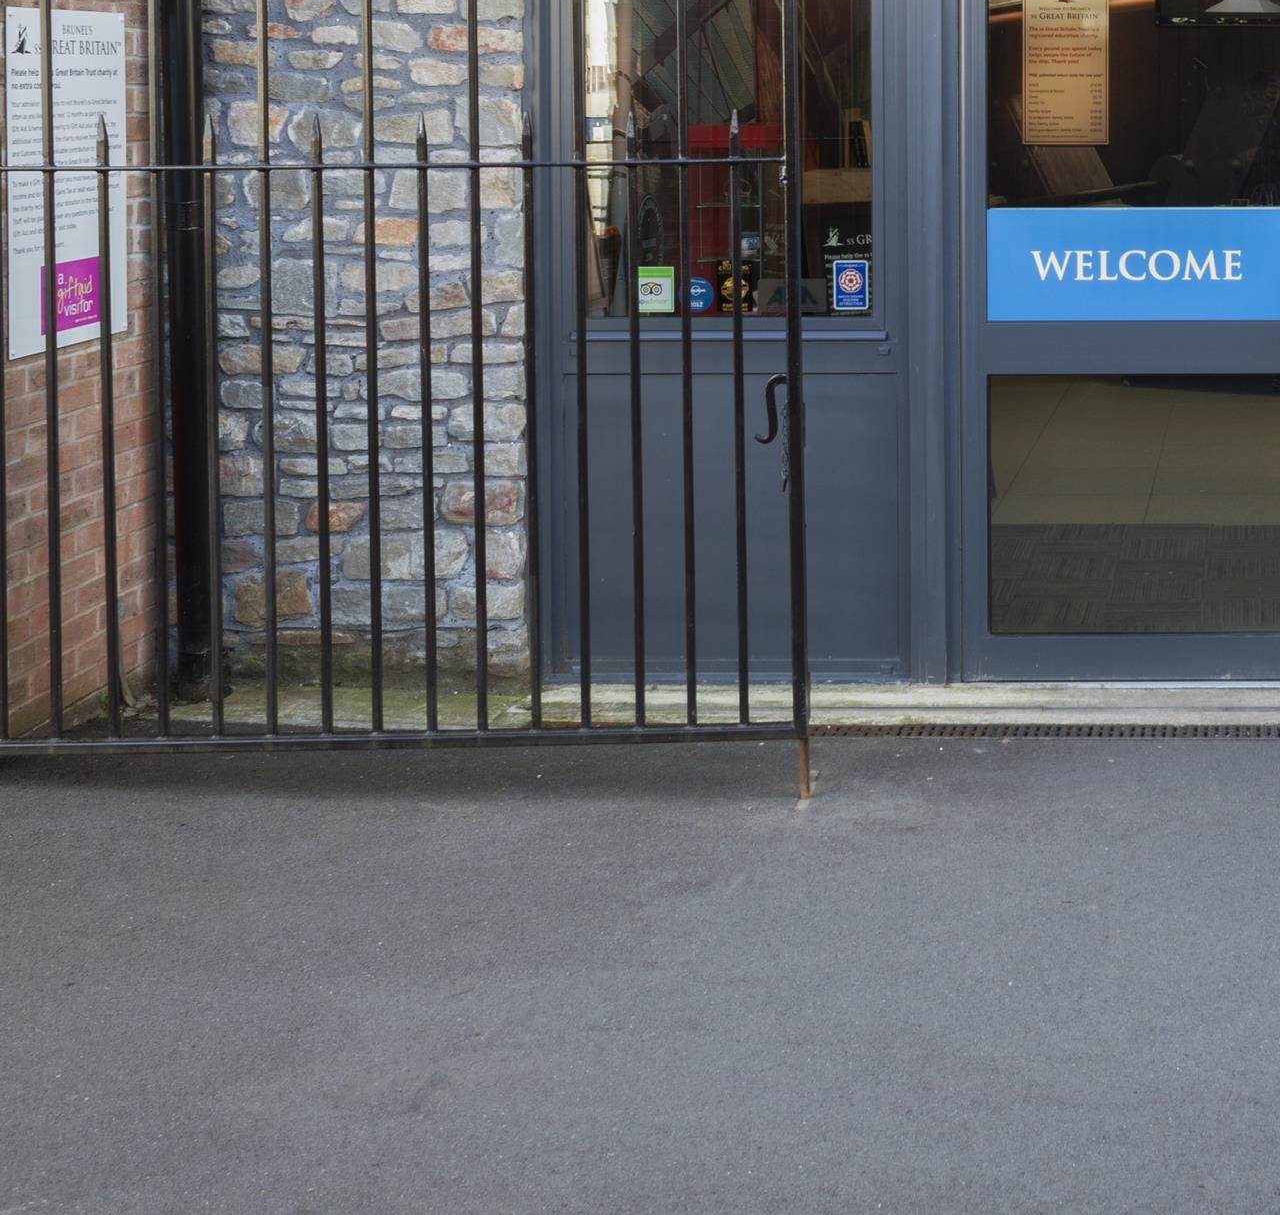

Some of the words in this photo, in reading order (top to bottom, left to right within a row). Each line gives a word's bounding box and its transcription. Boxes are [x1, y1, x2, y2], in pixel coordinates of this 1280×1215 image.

[1039, 12, 1064, 20] GREAT
[1066, 12, 1099, 20] BRITAIN
[52, 39, 77, 55] REAT
[11, 68, 27, 76] Please
[28, 68, 39, 77] help
[55, 68, 68, 76] Great
[69, 68, 84, 76] Britain
[86, 68, 96, 76] Trust
[97, 68, 112, 78] charity
[1030, 249, 1243, 282] WELCOME
[57, 273, 64, 285] a
[63, 294, 94, 317] visitor
